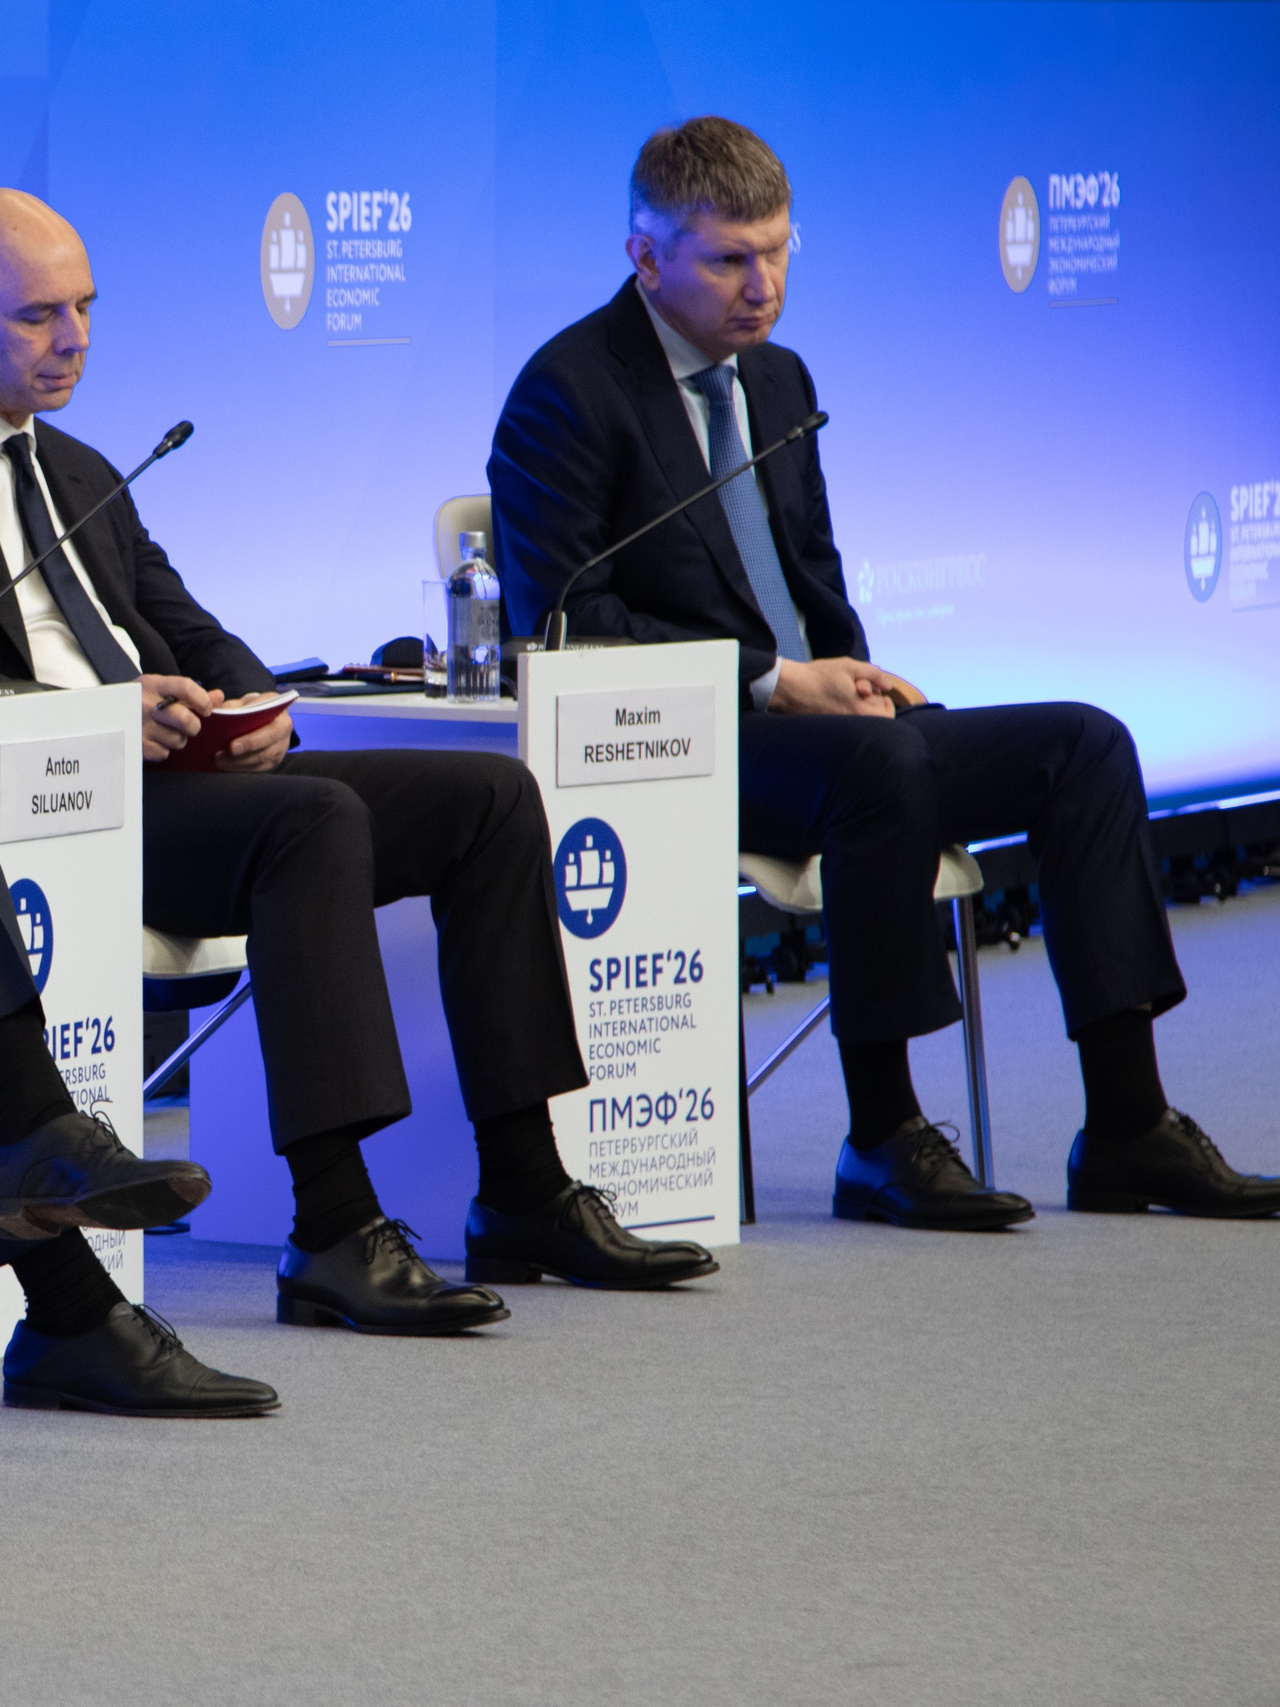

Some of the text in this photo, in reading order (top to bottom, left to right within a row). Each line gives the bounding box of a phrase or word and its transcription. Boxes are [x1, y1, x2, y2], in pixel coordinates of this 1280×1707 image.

[1049, 170, 1120, 209] ПМЭФ'26
[326, 188, 412, 232] SPIEF'26
[327, 239, 403, 259] ST. PETERSBURG
[327, 263, 406, 283] INTERNATIONAL
[327, 287, 380, 308] ECONOMIC
[327, 312, 362, 332] FORUM
[615, 706, 661, 727] Maxim
[584, 738, 691, 764] RESHETNIKOV
[45, 756, 80, 776] Anton
[31, 790, 93, 815] SILUANOV
[589, 949, 704, 993] SPIEF'26
[589, 992, 692, 1019] ST. PETERSBURG
[43, 1015, 115, 1062] IEF'26
[589, 1014, 696, 1039] INTERNATIONAL
[589, 1038, 661, 1061] ECONOMIC
[589, 1062, 637, 1081] FORUM
[589, 1087, 715, 1134] ПМЭФ'26
[589, 1129, 698, 1158] ПЕТЕРБУРГСКИЙ
[589, 1149, 717, 1179] МЕЖДУНАРОДНЫЙ
[597, 1168, 713, 1197] КОНОМИЧЕСКИЙ
[612, 1201, 638, 1218] РУМ
